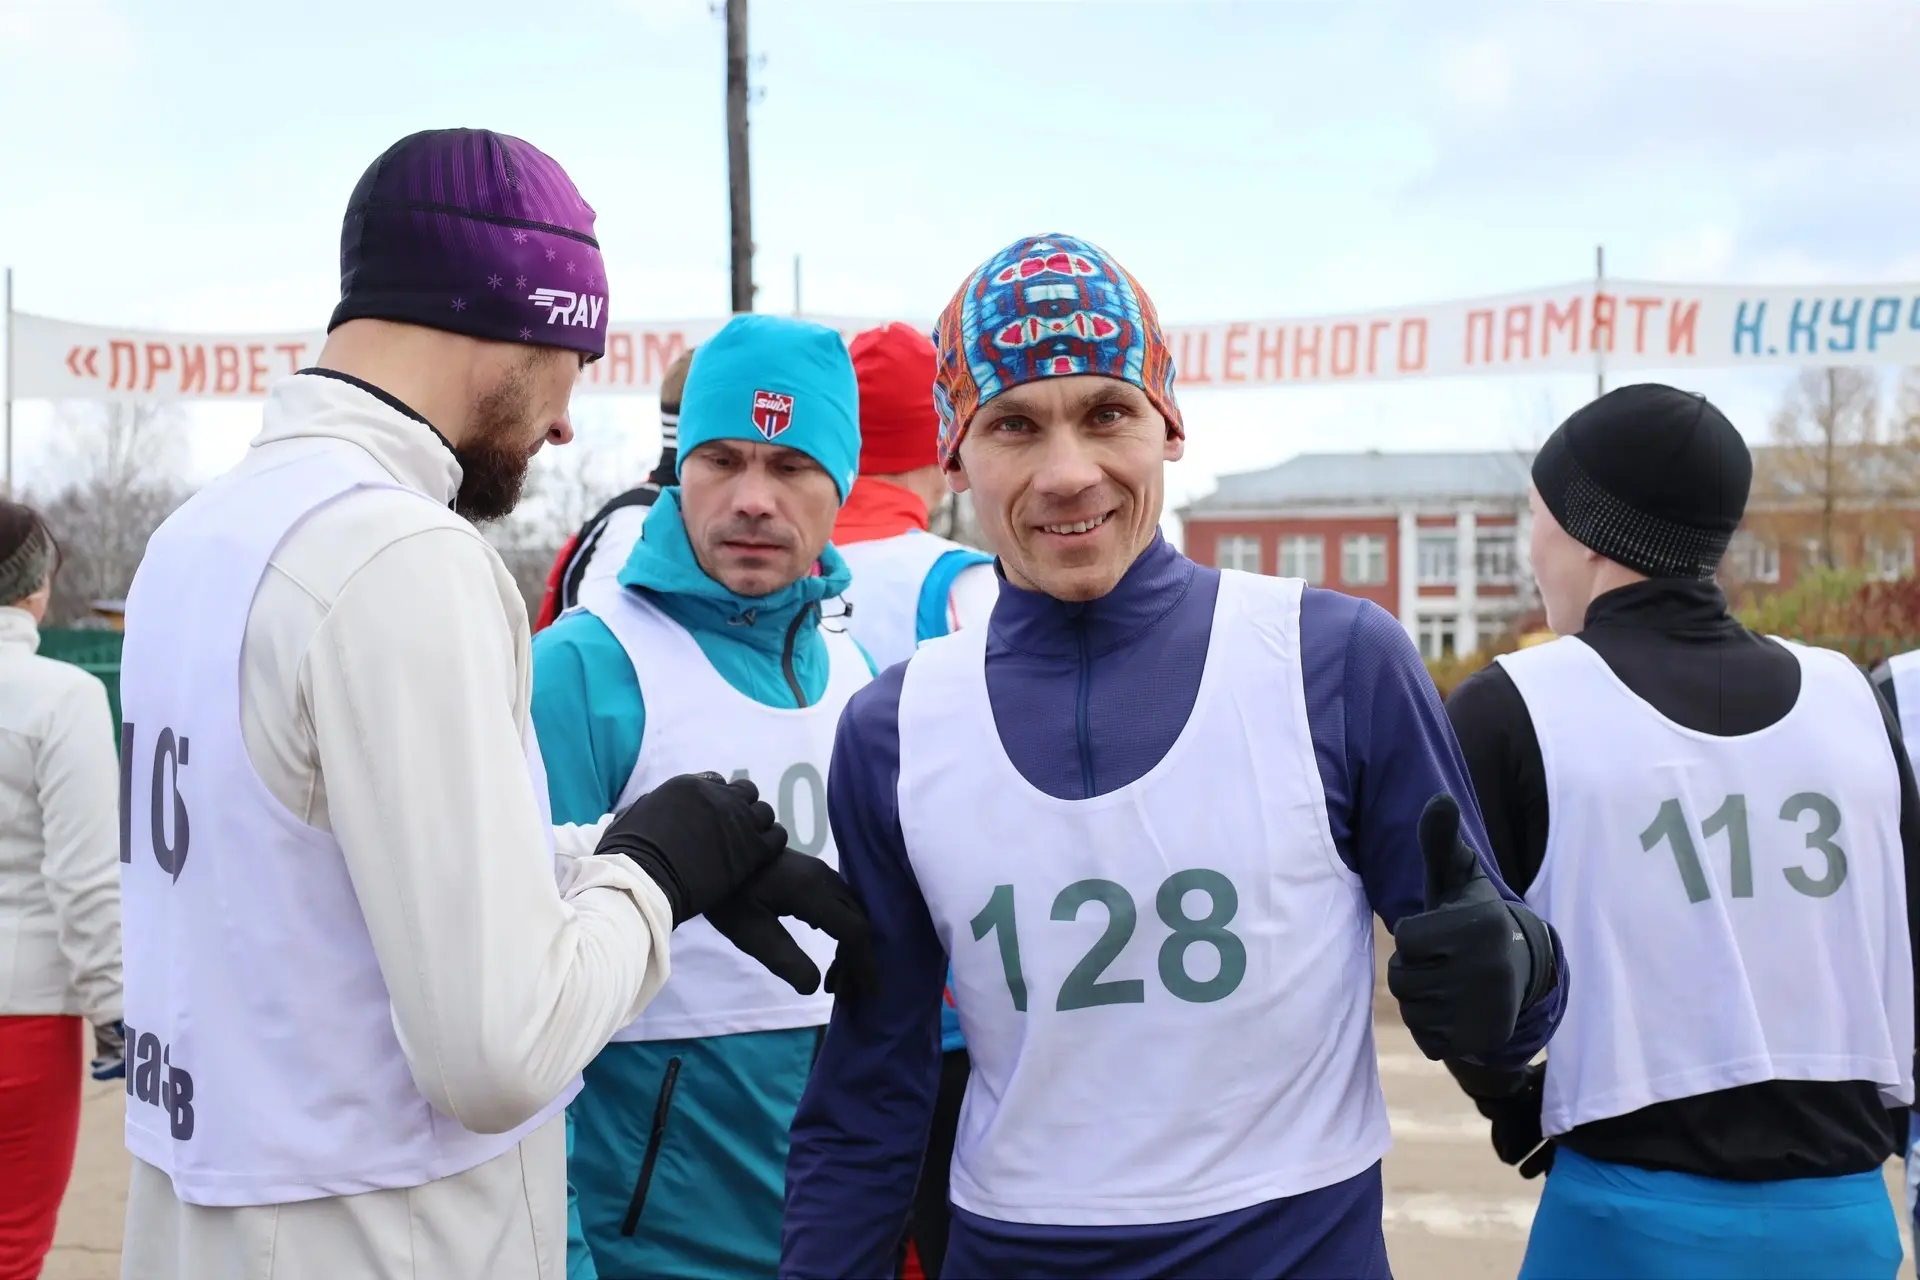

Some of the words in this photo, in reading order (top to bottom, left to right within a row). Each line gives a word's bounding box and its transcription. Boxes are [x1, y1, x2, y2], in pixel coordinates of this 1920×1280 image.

[528, 288, 603, 329] RAY
[1464, 293, 1701, 364] ПАМЯТИ
[1639, 791, 1848, 904] 113
[970, 868, 1247, 1013] 128
